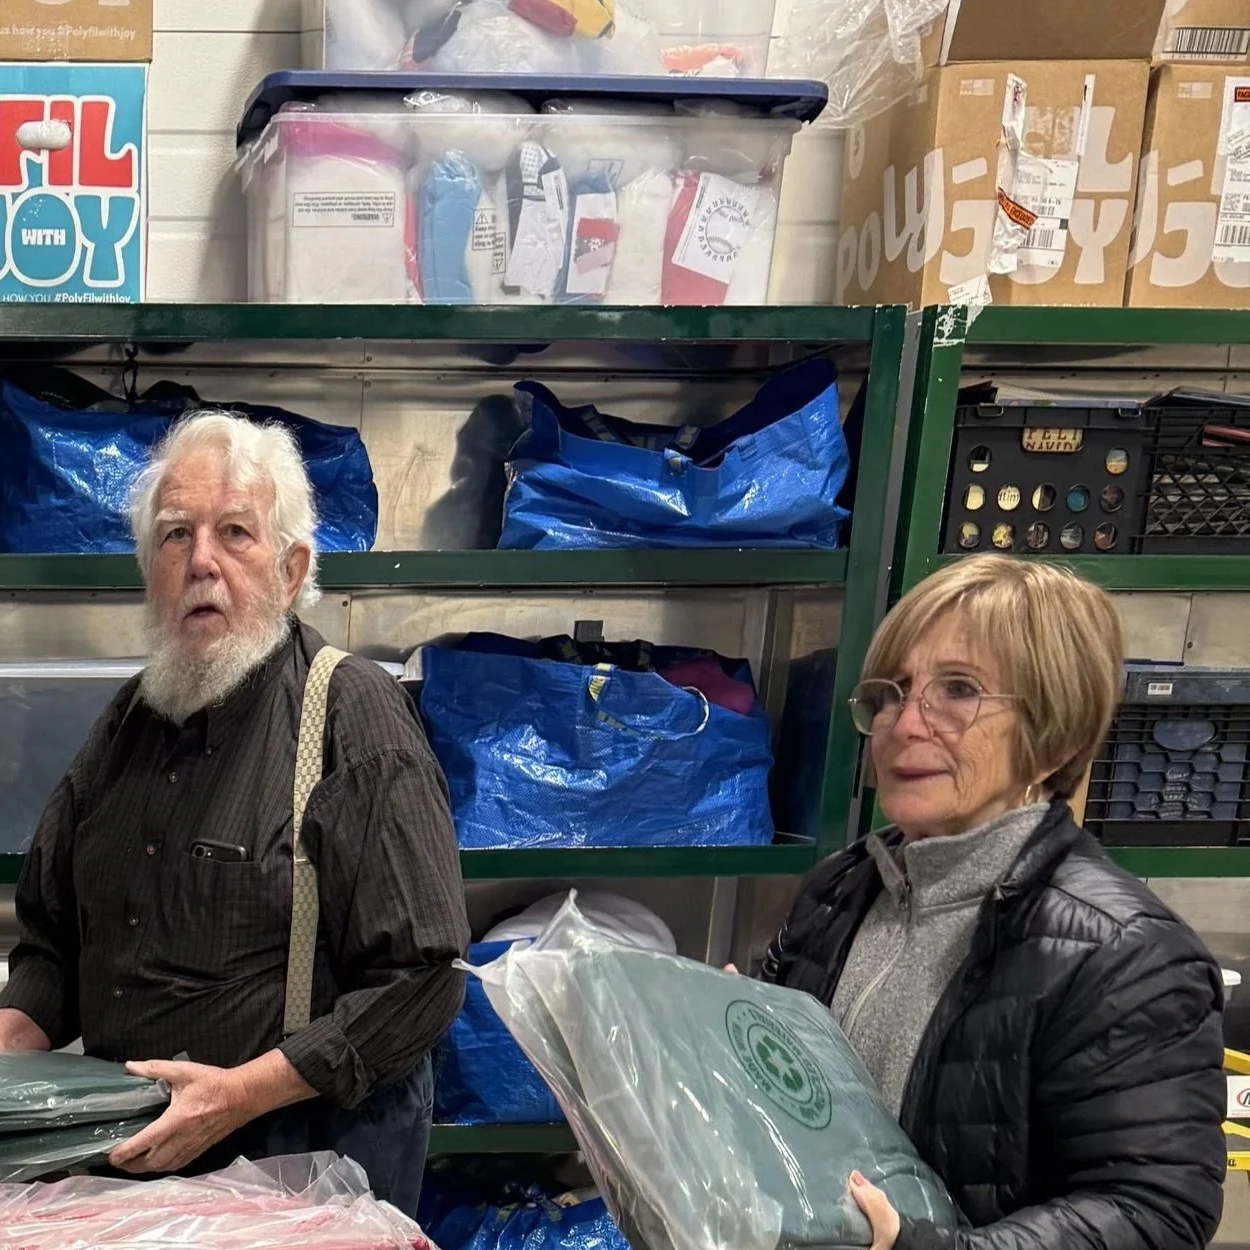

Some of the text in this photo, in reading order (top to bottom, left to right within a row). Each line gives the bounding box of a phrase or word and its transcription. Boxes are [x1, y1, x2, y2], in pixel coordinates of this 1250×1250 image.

[12, 24, 34, 36] how
[36, 26, 55, 39] you
[21, 228, 66, 246] WITH
[2, 293, 27, 302] HOW
[29, 293, 49, 302] YOU
